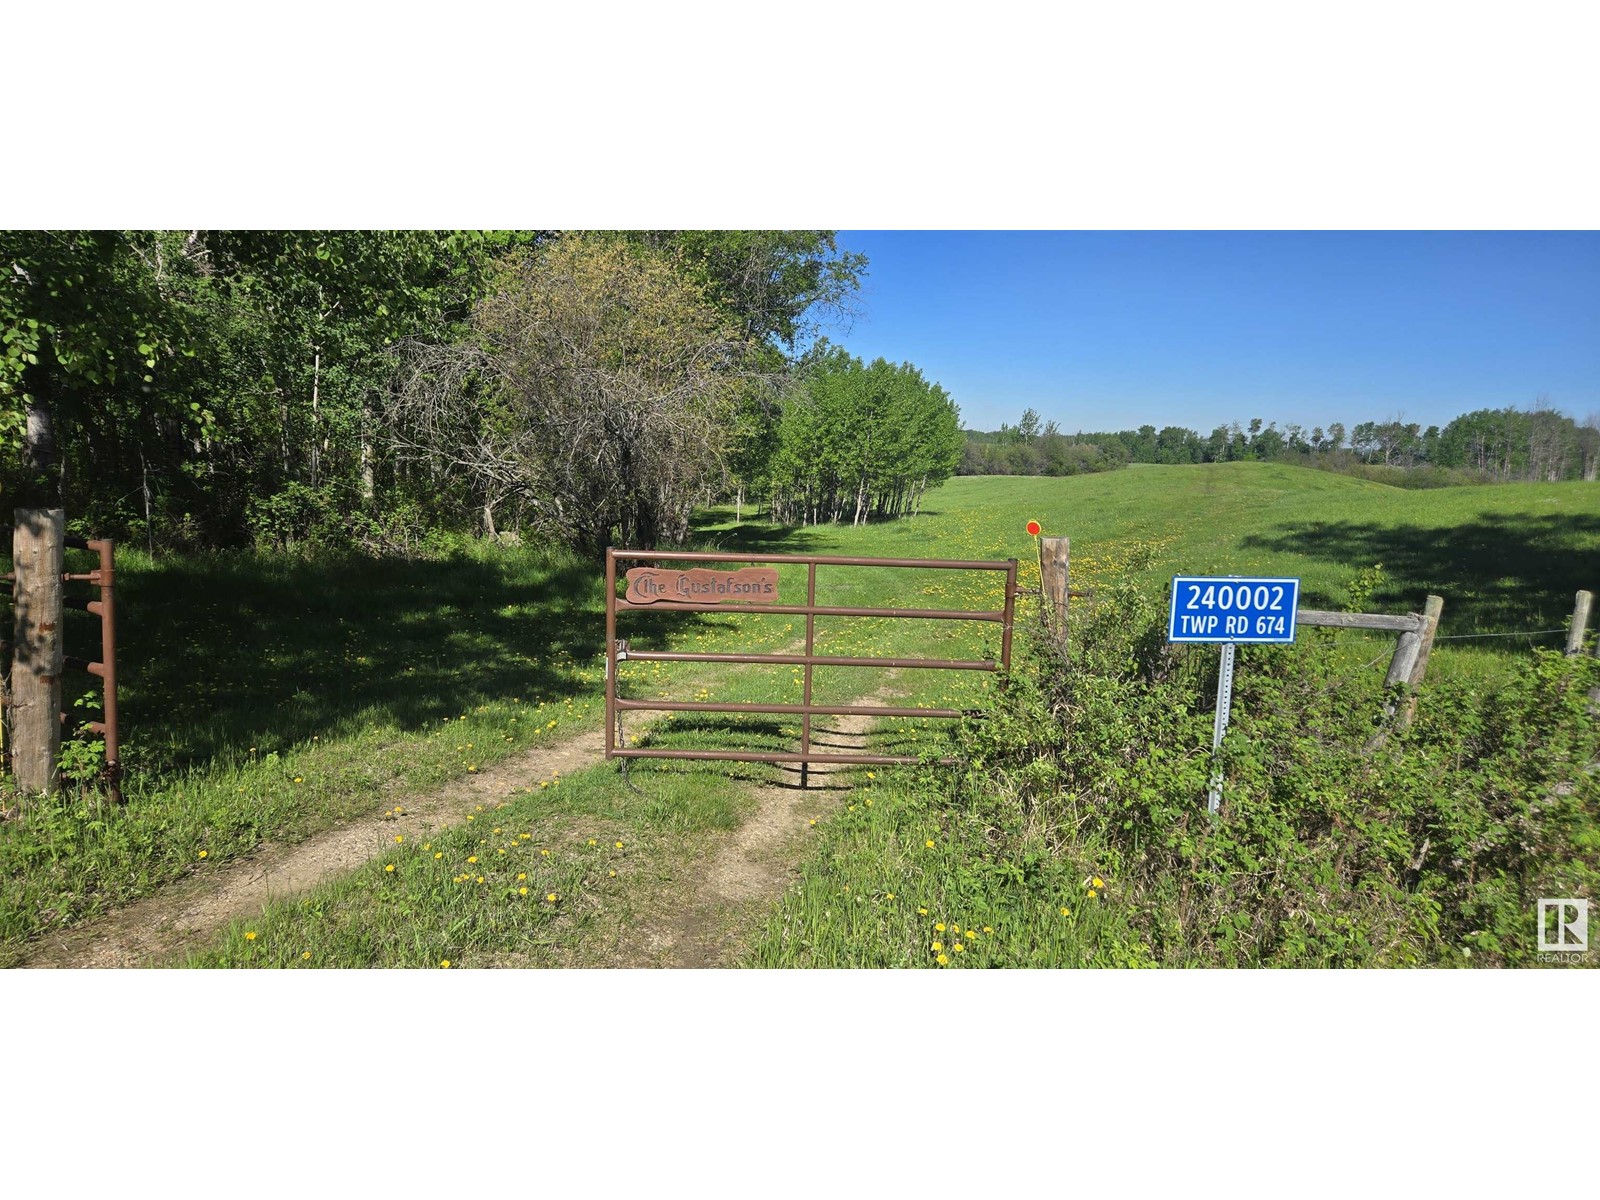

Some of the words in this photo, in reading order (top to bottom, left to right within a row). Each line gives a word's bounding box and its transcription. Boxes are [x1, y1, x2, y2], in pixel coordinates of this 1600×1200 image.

[633, 572, 667, 598] The
[676, 574, 773, 599] Gustafson's
[1186, 585, 1284, 611] 240002
[1180, 615, 1219, 634] TWP
[1225, 616, 1249, 634] RD
[1256, 616, 1285, 635] 674
